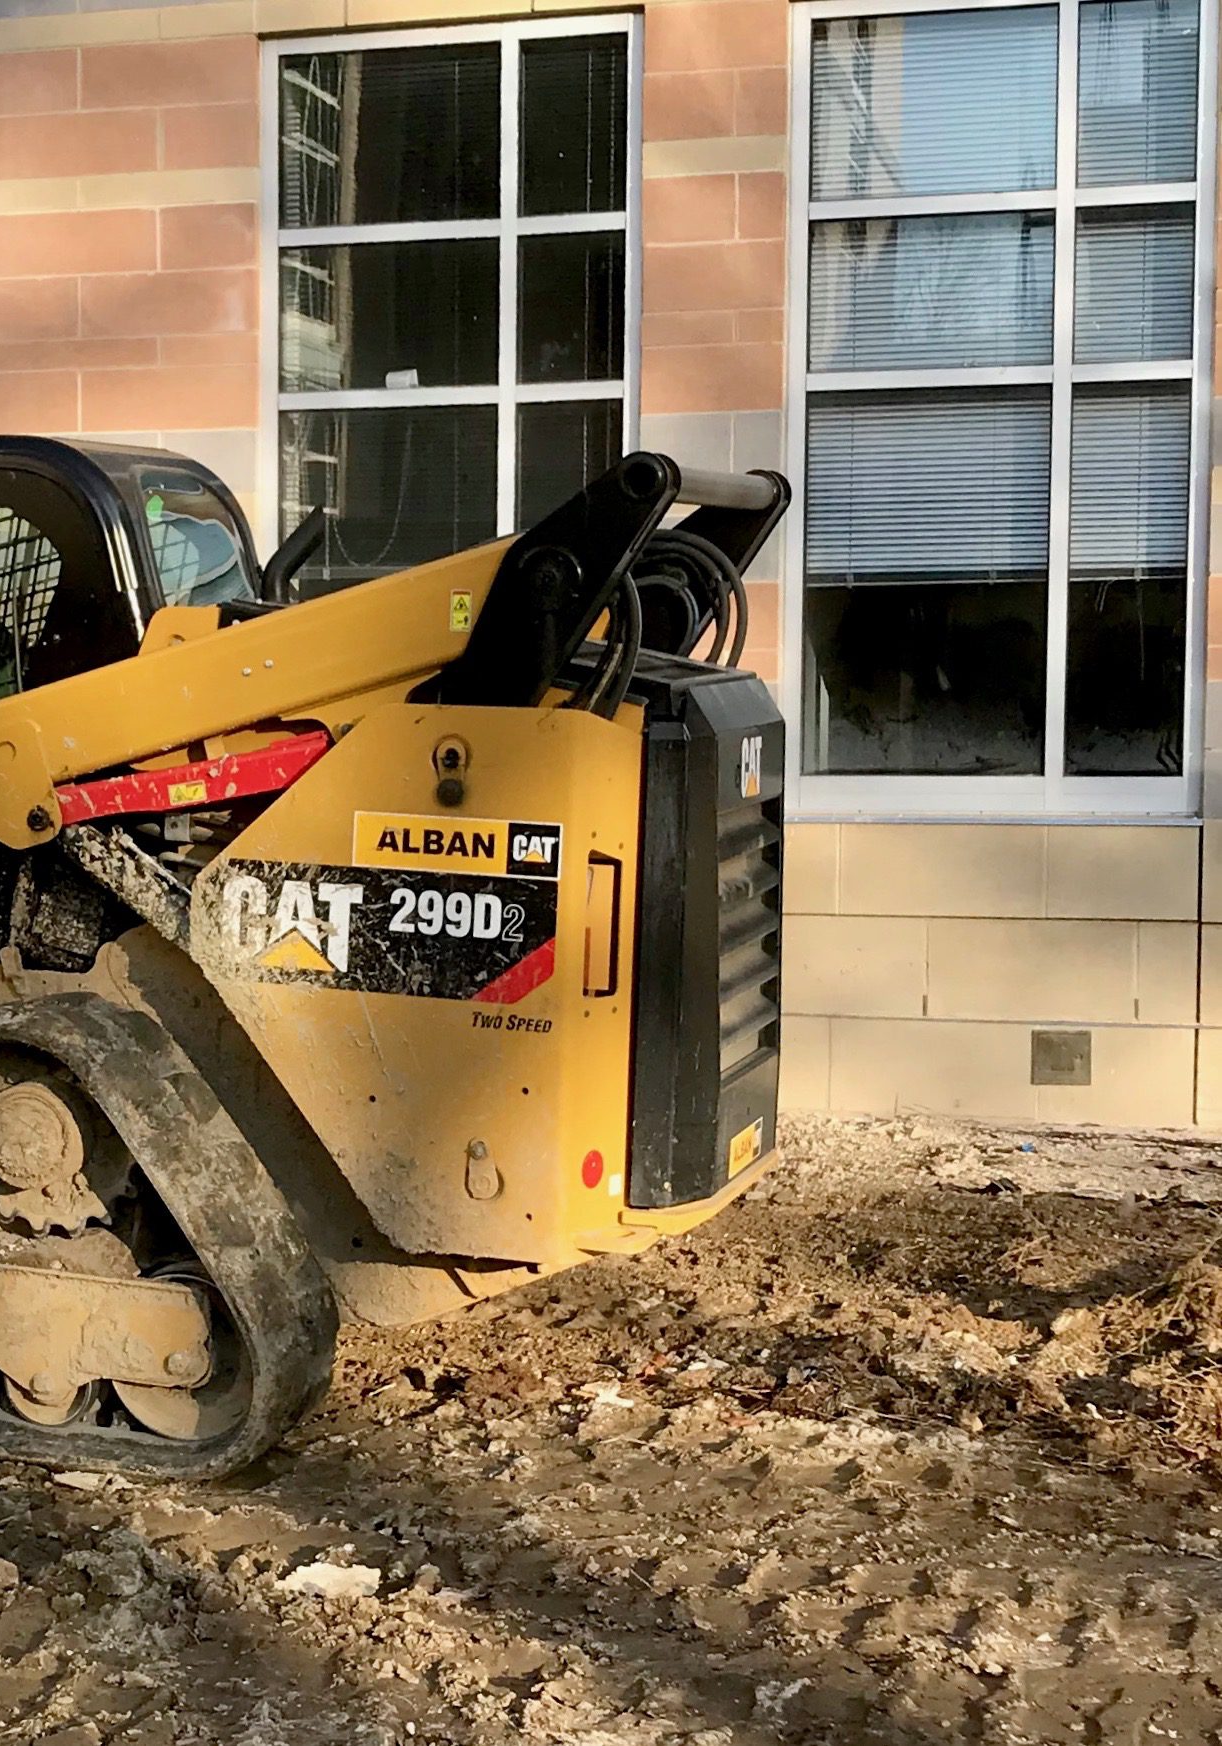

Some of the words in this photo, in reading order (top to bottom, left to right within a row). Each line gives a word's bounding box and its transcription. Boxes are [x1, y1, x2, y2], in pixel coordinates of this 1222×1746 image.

[741, 736, 762, 799] CAT
[376, 827, 495, 859] ALBAN
[512, 834, 557, 864] CAT
[223, 875, 364, 973] CAT
